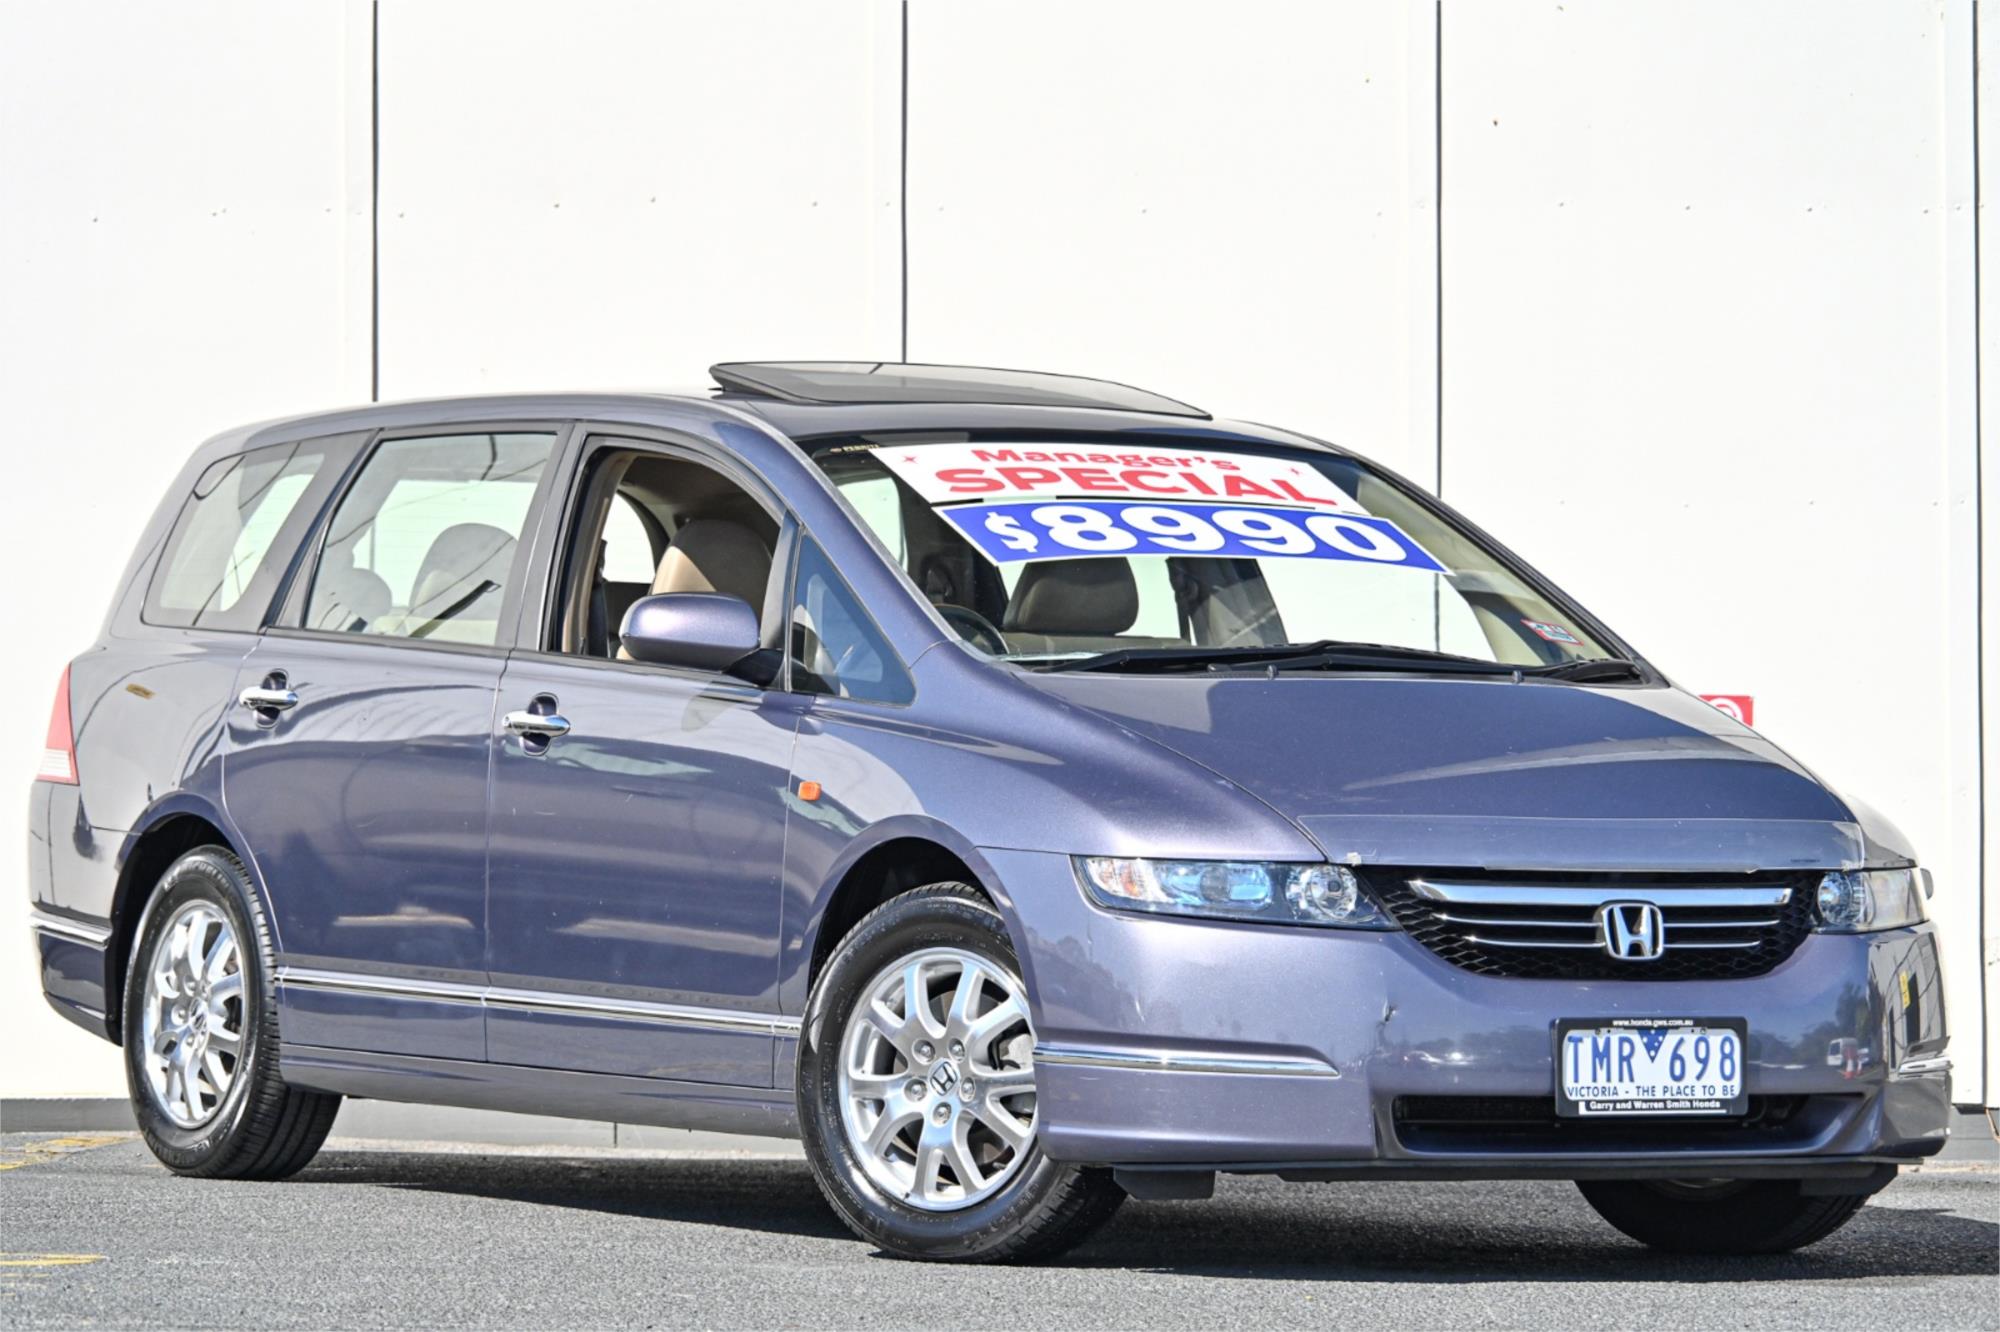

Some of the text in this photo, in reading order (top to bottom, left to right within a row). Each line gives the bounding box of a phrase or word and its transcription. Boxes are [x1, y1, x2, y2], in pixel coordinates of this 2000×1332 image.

[970, 449, 1241, 471] Manager's
[935, 466, 1338, 506] SPECIAL
[984, 505, 1408, 562] $8990
[1567, 1035, 1736, 1083] TMR 698
[1567, 1085, 1619, 1098] VICTORIA
[1635, 1085, 1656, 1097] THE
[1662, 1085, 1696, 1097] PLACE
[1702, 1085, 1716, 1097] TO
[1722, 1084, 1735, 1097] BE
[1589, 1100, 1721, 1111] Garry and Warren Smith Honda
